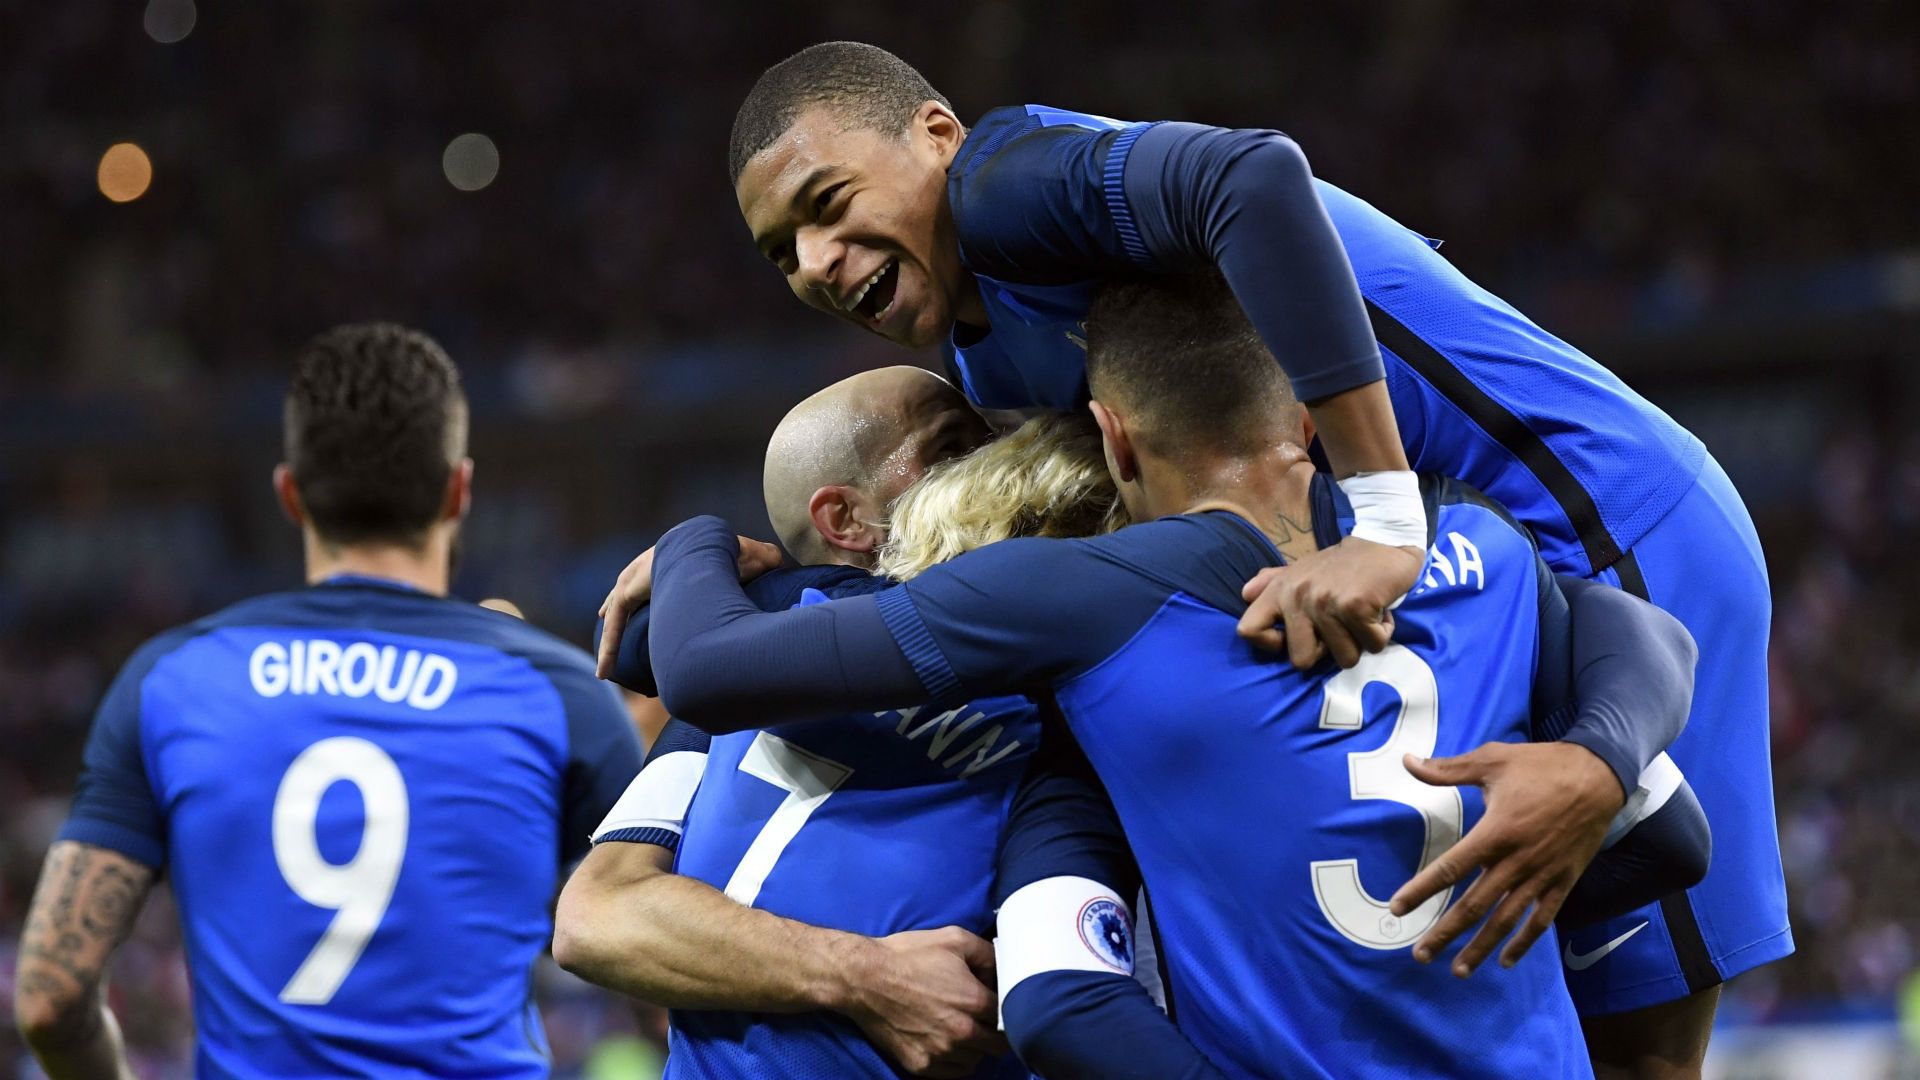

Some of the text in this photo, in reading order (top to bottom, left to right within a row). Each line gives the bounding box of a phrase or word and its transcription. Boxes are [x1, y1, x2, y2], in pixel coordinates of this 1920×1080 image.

[249, 639, 458, 710] GIROUD
[272, 736, 410, 1005] 9
[723, 730, 855, 908] 7
[1310, 643, 1464, 950] 3
